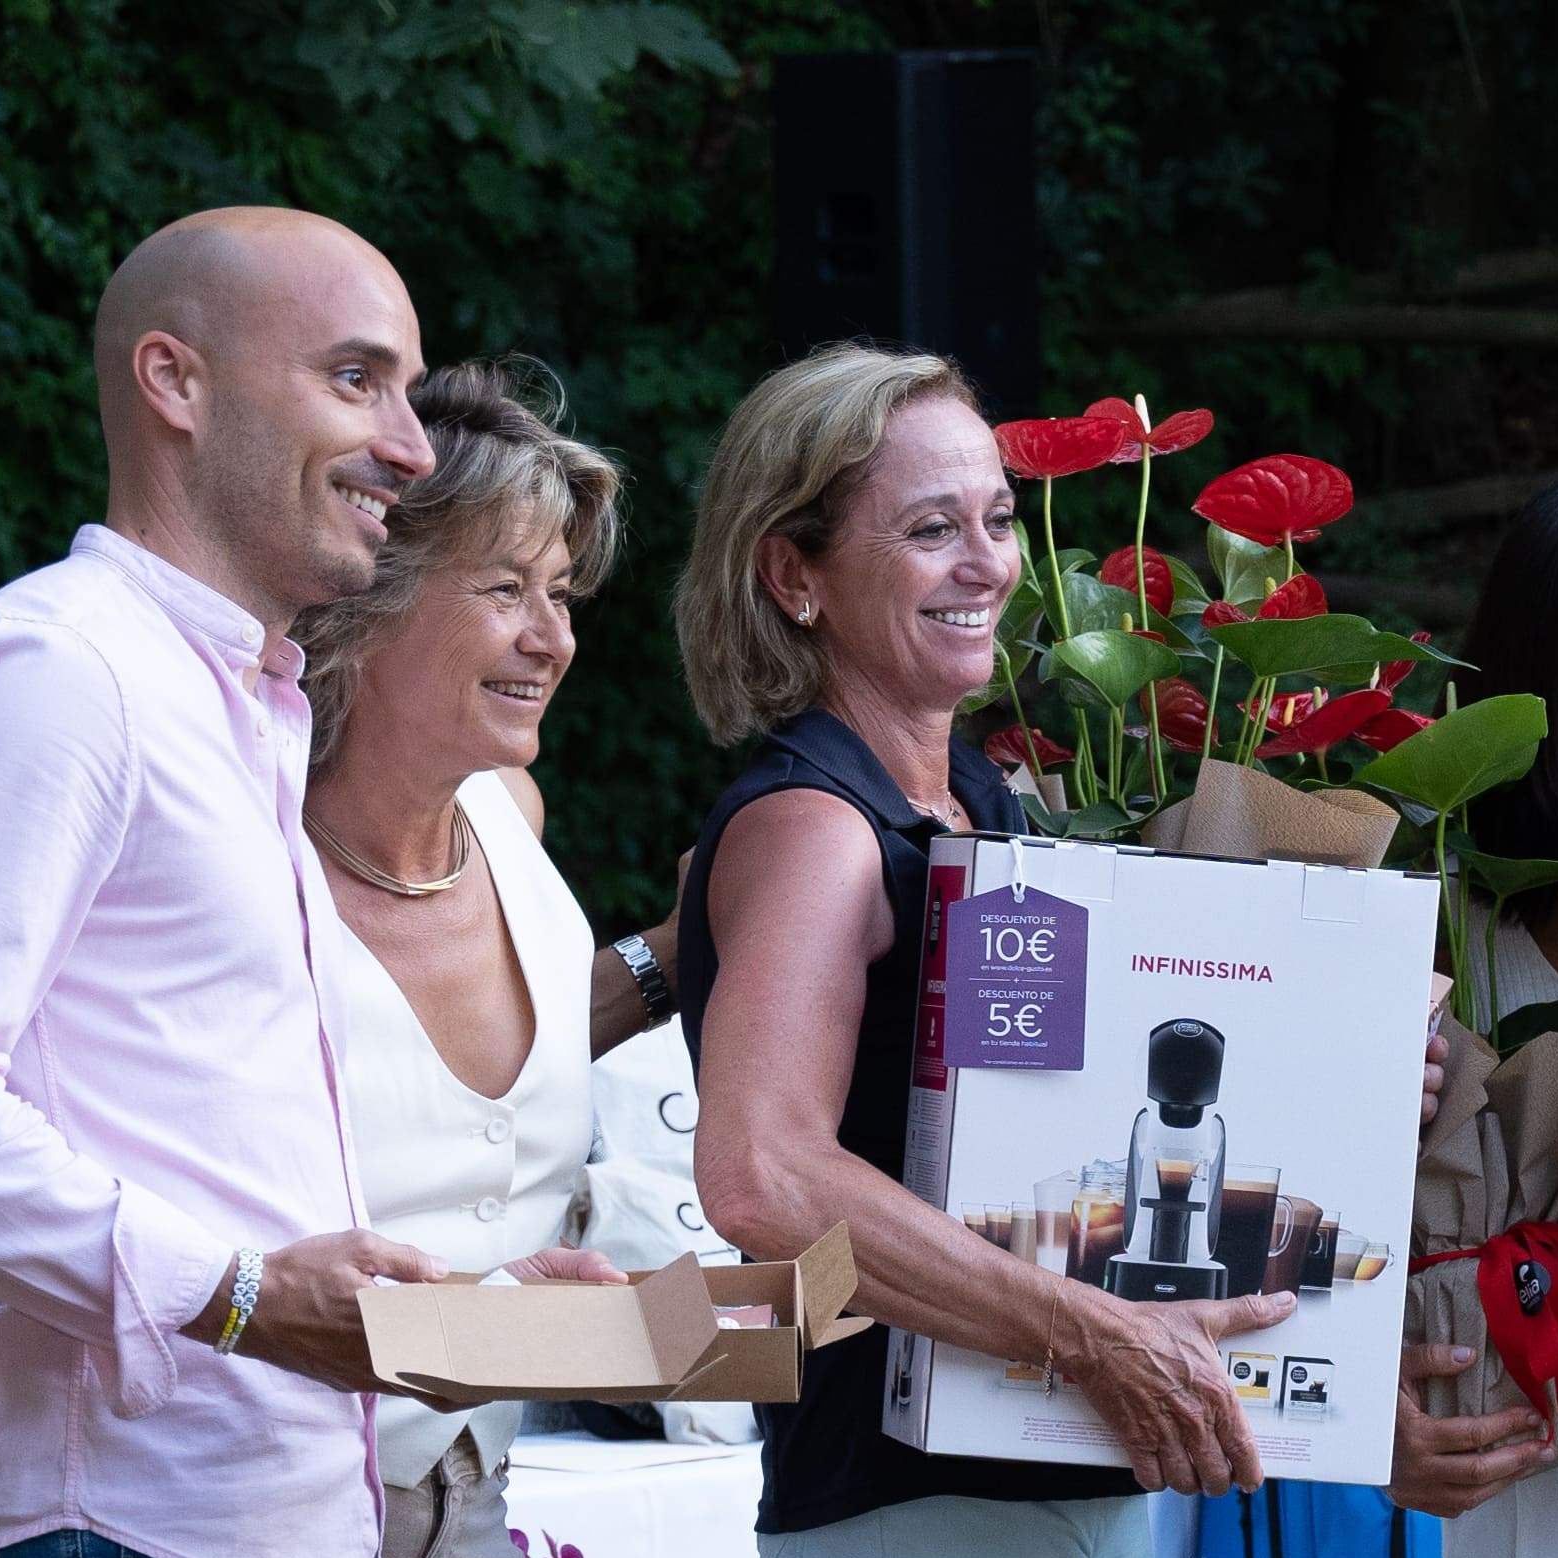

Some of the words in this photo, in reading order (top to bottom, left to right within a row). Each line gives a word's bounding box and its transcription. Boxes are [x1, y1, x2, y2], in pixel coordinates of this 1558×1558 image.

[980, 914, 1041, 924] DESCUENTO
[1042, 916, 1057, 924] DE
[1131, 954, 1273, 983] INFINISSIMA
[978, 989, 1038, 1000] DESCUENTO
[1039, 991, 1054, 1000] DE
